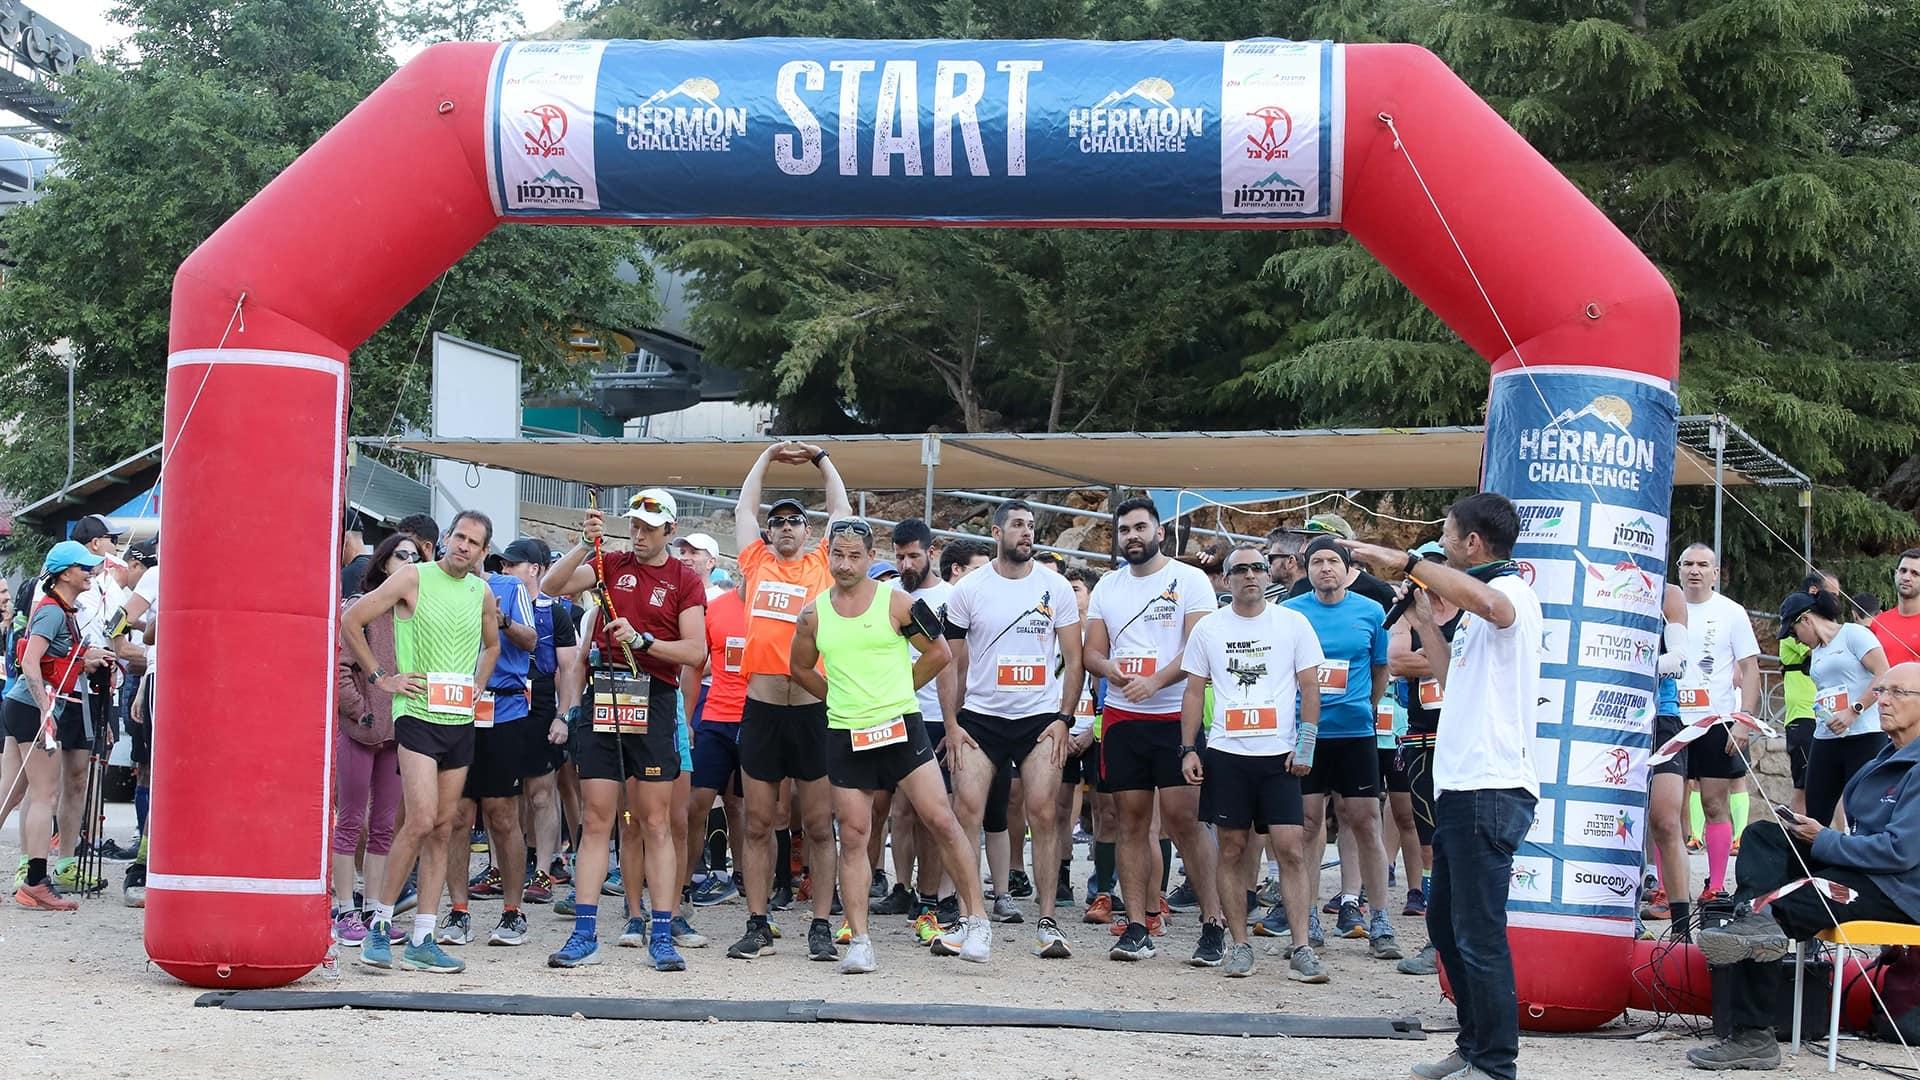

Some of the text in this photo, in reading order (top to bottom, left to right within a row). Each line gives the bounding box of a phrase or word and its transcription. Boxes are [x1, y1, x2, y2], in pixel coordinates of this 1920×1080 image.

[616, 107, 747, 137] HERMON
[774, 60, 1043, 176] START
[1068, 107, 1204, 138] HERMON
[627, 135, 731, 152] CHALLENEGE
[1079, 135, 1187, 154] CHALLENEGE
[1519, 428, 1655, 473] HERMON
[1528, 462, 1640, 491] CHALLENGE
[768, 592, 790, 609] 115
[1597, 634, 1632, 648] משרד
[1585, 646, 1631, 661] התיירות
[1011, 666, 1033, 681] 110
[443, 685, 464, 702] 176
[1596, 689, 1648, 709] MARATHON
[1680, 690, 1696, 704] 99
[1242, 709, 1260, 725] 70
[1590, 702, 1628, 719] ISRAEL
[865, 727, 892, 742] 100
[1586, 820, 1614, 829] התרבות
[1595, 813, 1614, 822] משרד
[1583, 828, 1614, 837] והספורט
[1575, 872, 1628, 889] saucony
